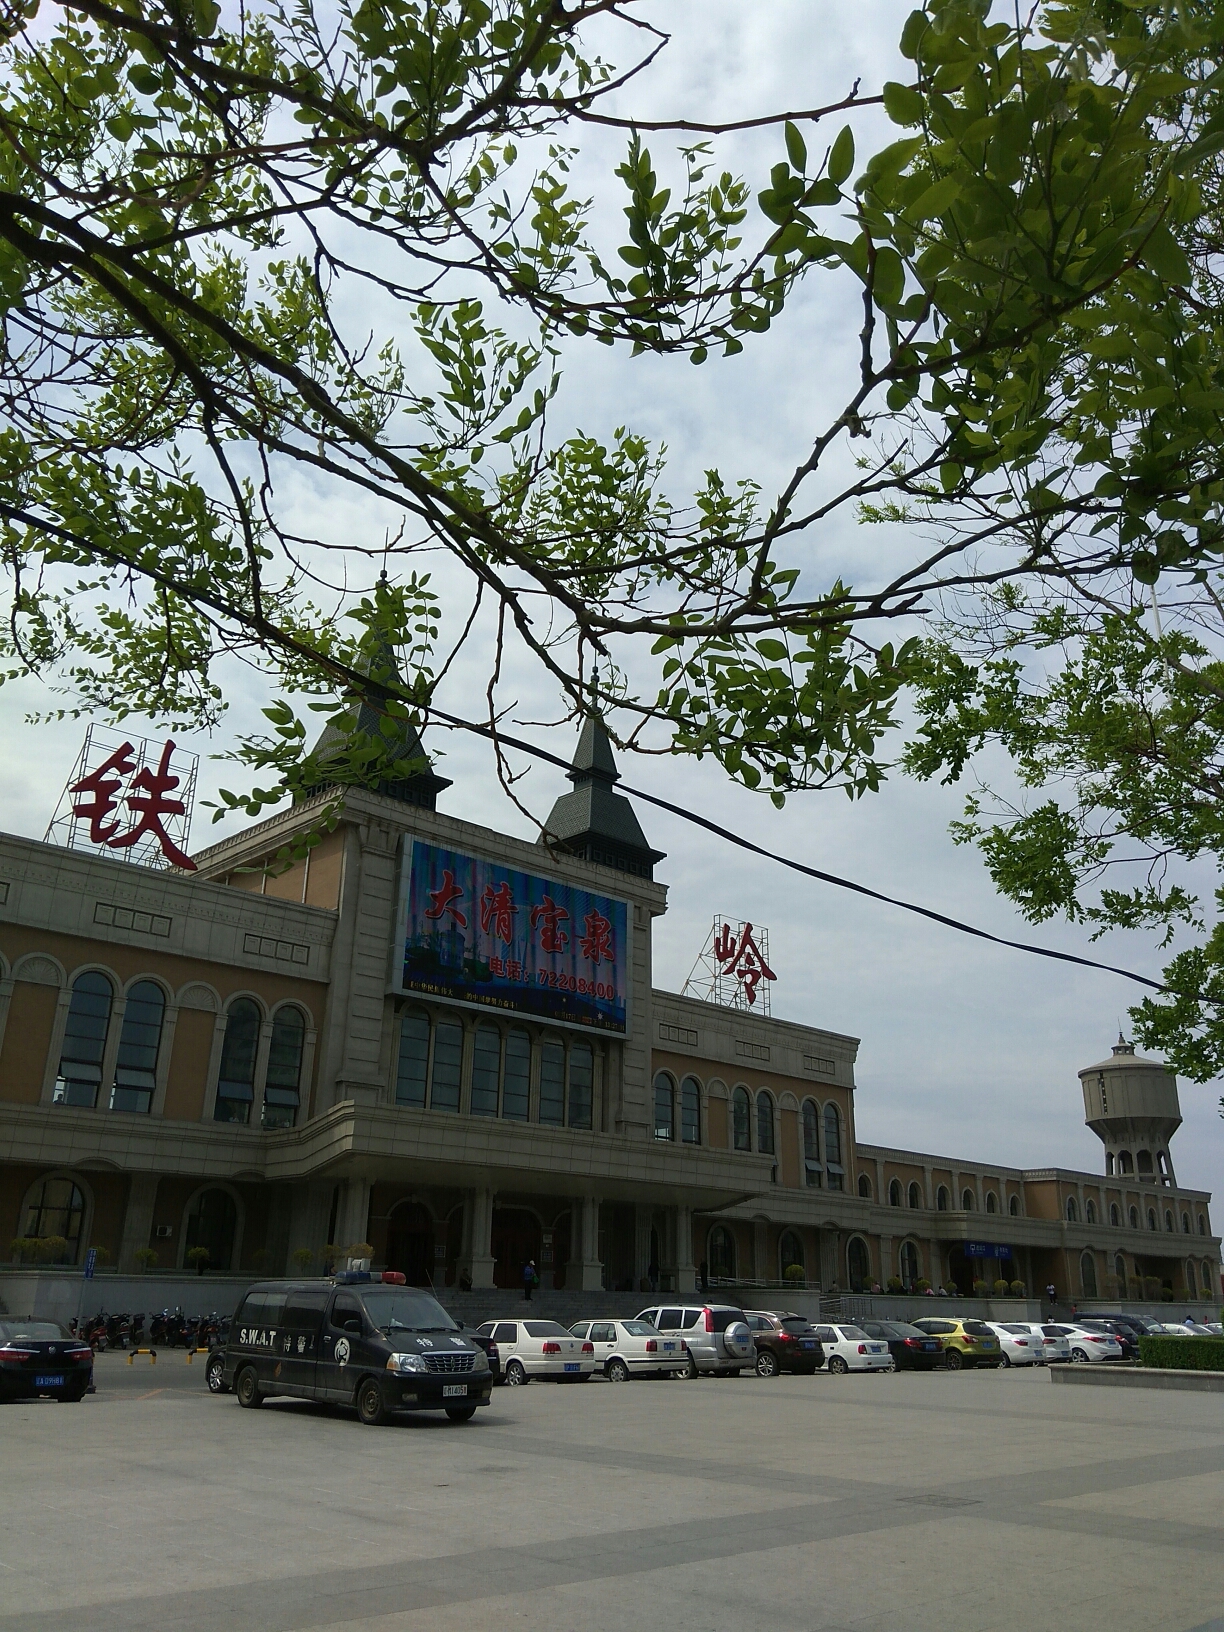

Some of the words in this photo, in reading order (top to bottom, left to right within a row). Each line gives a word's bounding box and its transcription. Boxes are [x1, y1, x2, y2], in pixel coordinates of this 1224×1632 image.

[69, 739, 198, 871] 铁
[424, 869, 615, 964] 大清宝泉
[715, 922, 777, 1005] 岭
[239, 1328, 277, 1346] S.W.A.T
